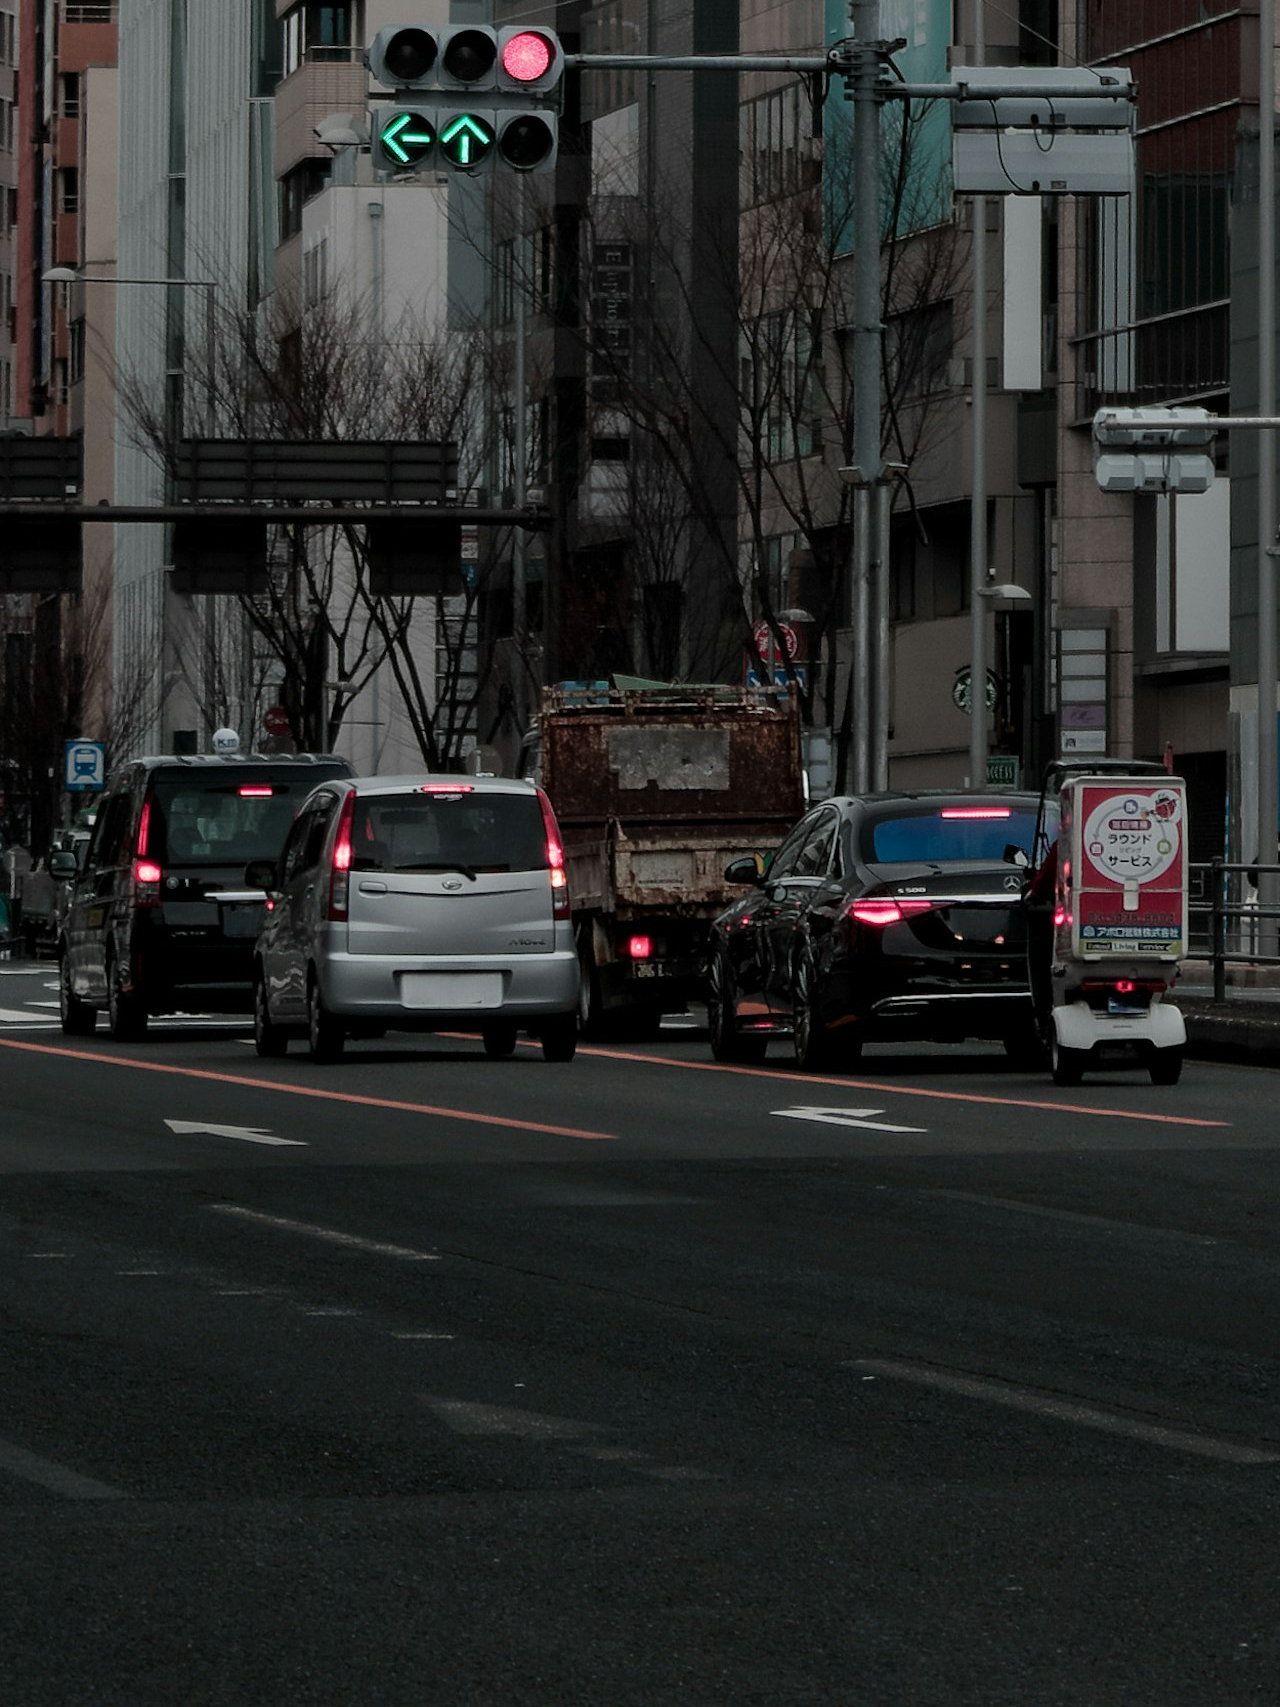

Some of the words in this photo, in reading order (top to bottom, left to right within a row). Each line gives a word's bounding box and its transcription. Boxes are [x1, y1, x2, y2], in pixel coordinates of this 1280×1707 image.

[1108, 834, 1152, 844] ラウンド
[1108, 855, 1152, 867] サービス
